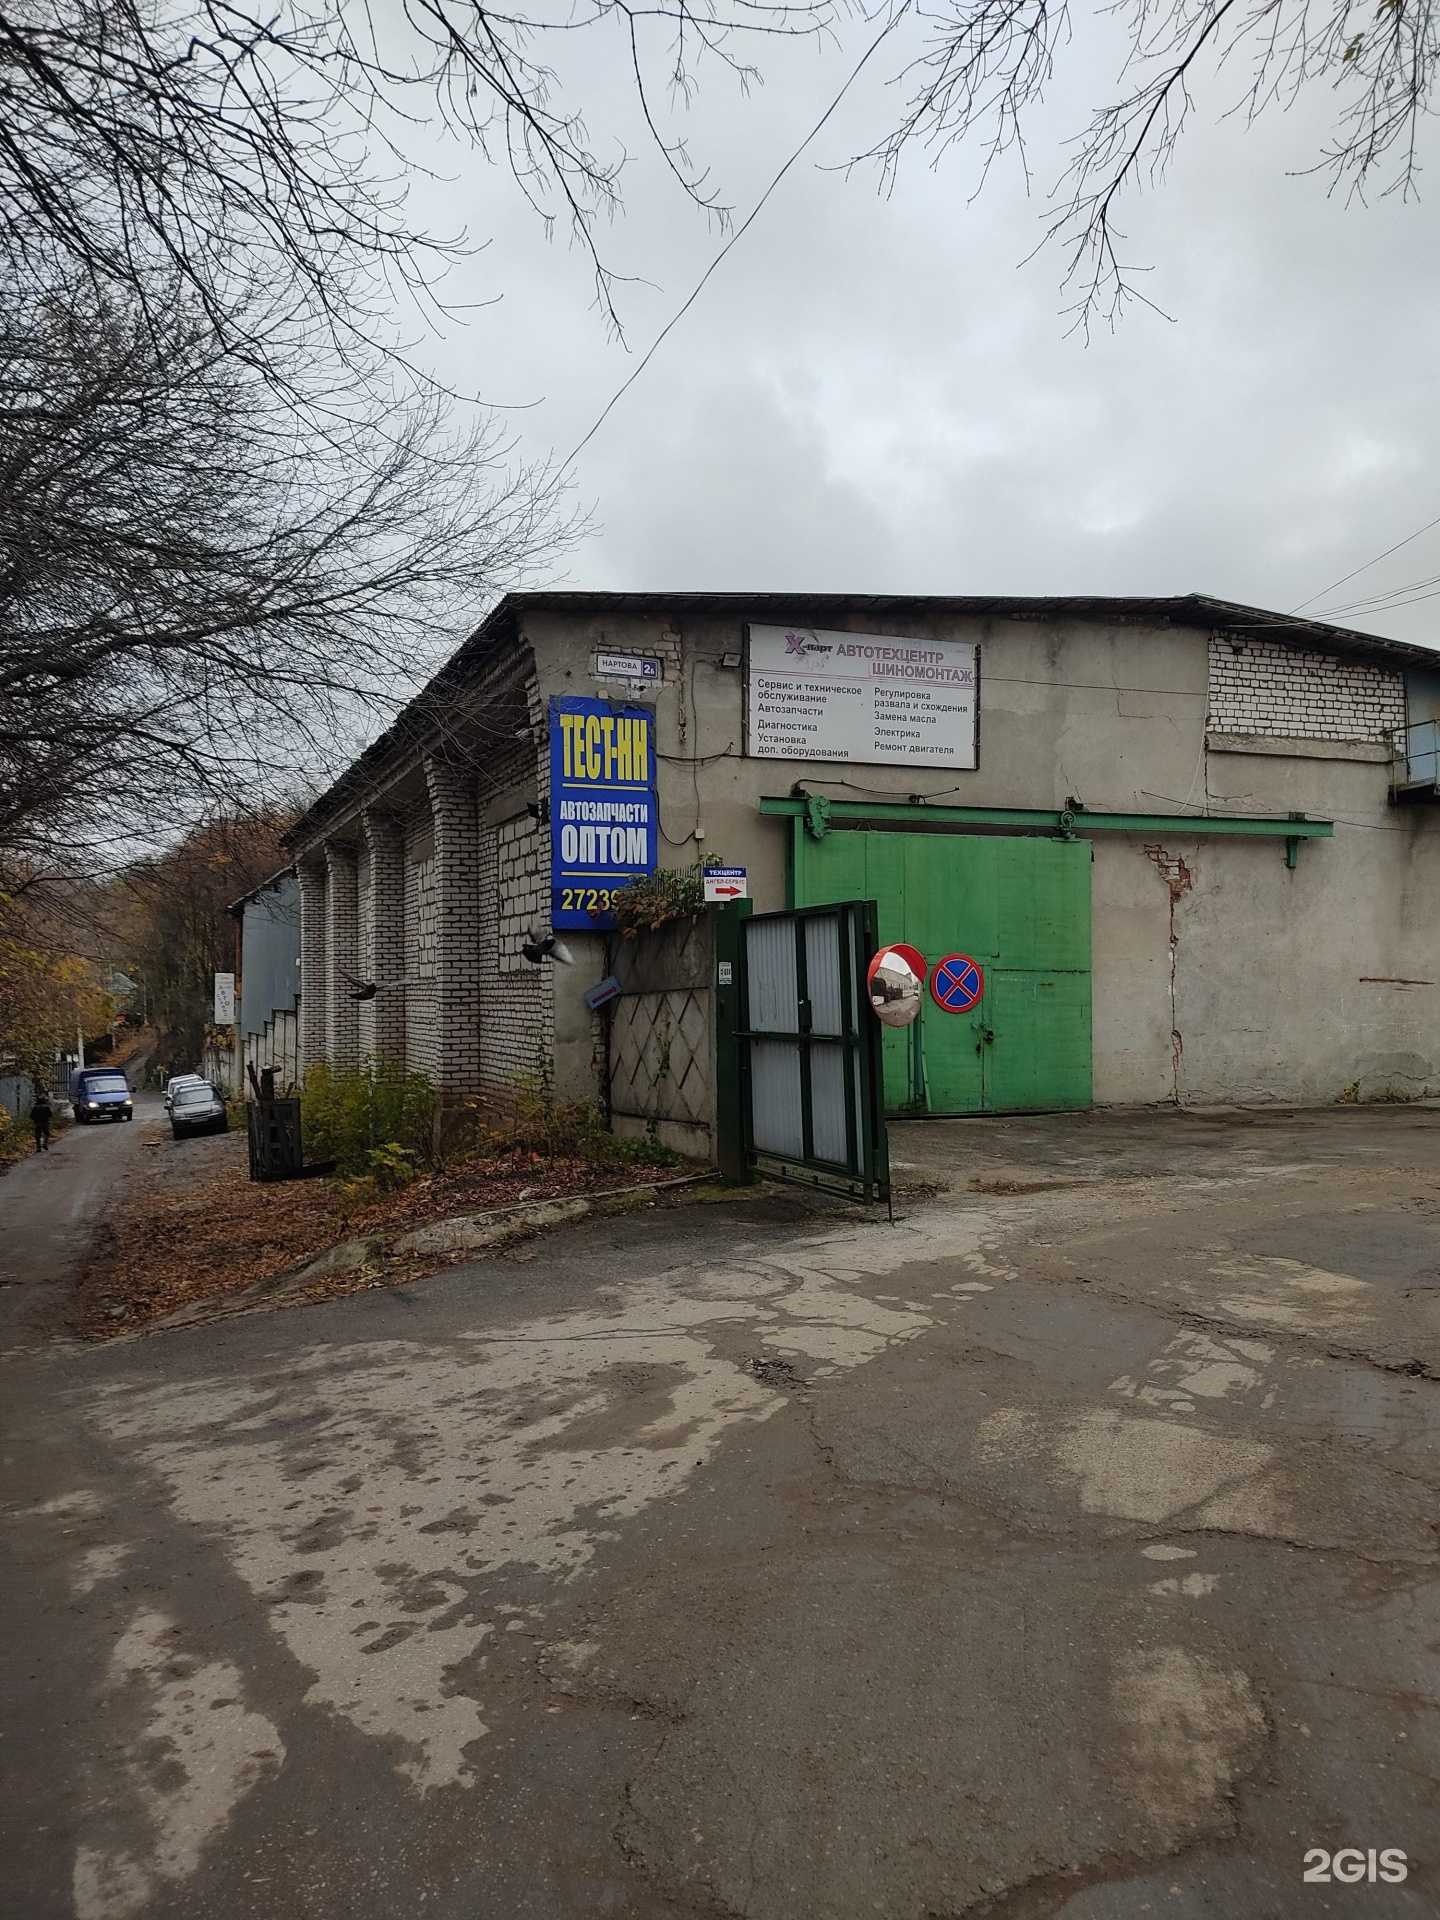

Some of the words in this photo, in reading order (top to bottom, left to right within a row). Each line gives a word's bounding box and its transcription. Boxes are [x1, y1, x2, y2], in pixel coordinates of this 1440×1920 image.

[836, 643, 944, 664] АВТОТЕХЦЕНТР
[602, 660, 637, 669] НАРТОВА
[872, 662, 973, 683] ШИНОМОНТАЖ
[757, 679, 793, 691] Сервис
[804, 683, 862, 695] техническое
[874, 687, 931, 700] Регулировка
[757, 690, 827, 703] обслуживание
[757, 703, 824, 716] Автозапчасти
[874, 700, 911, 709] развала
[920, 703, 968, 713] схождения
[874, 711, 907, 722] Замена
[909, 715, 937, 724] масла
[757, 719, 818, 732] Диагностика
[757, 733, 807, 745] Установка
[874, 727, 921, 738] Электрика
[560, 714, 648, 781] ТЕСТ-НН
[757, 746, 778, 755] доп.
[781, 746, 849, 758] оборудования
[874, 741, 906, 752] Ремонт
[908, 745, 954, 754] двигателя
[560, 800, 648, 823] АВТОЗАПЧАСТИ
[561, 824, 648, 865] ОПТОМ
